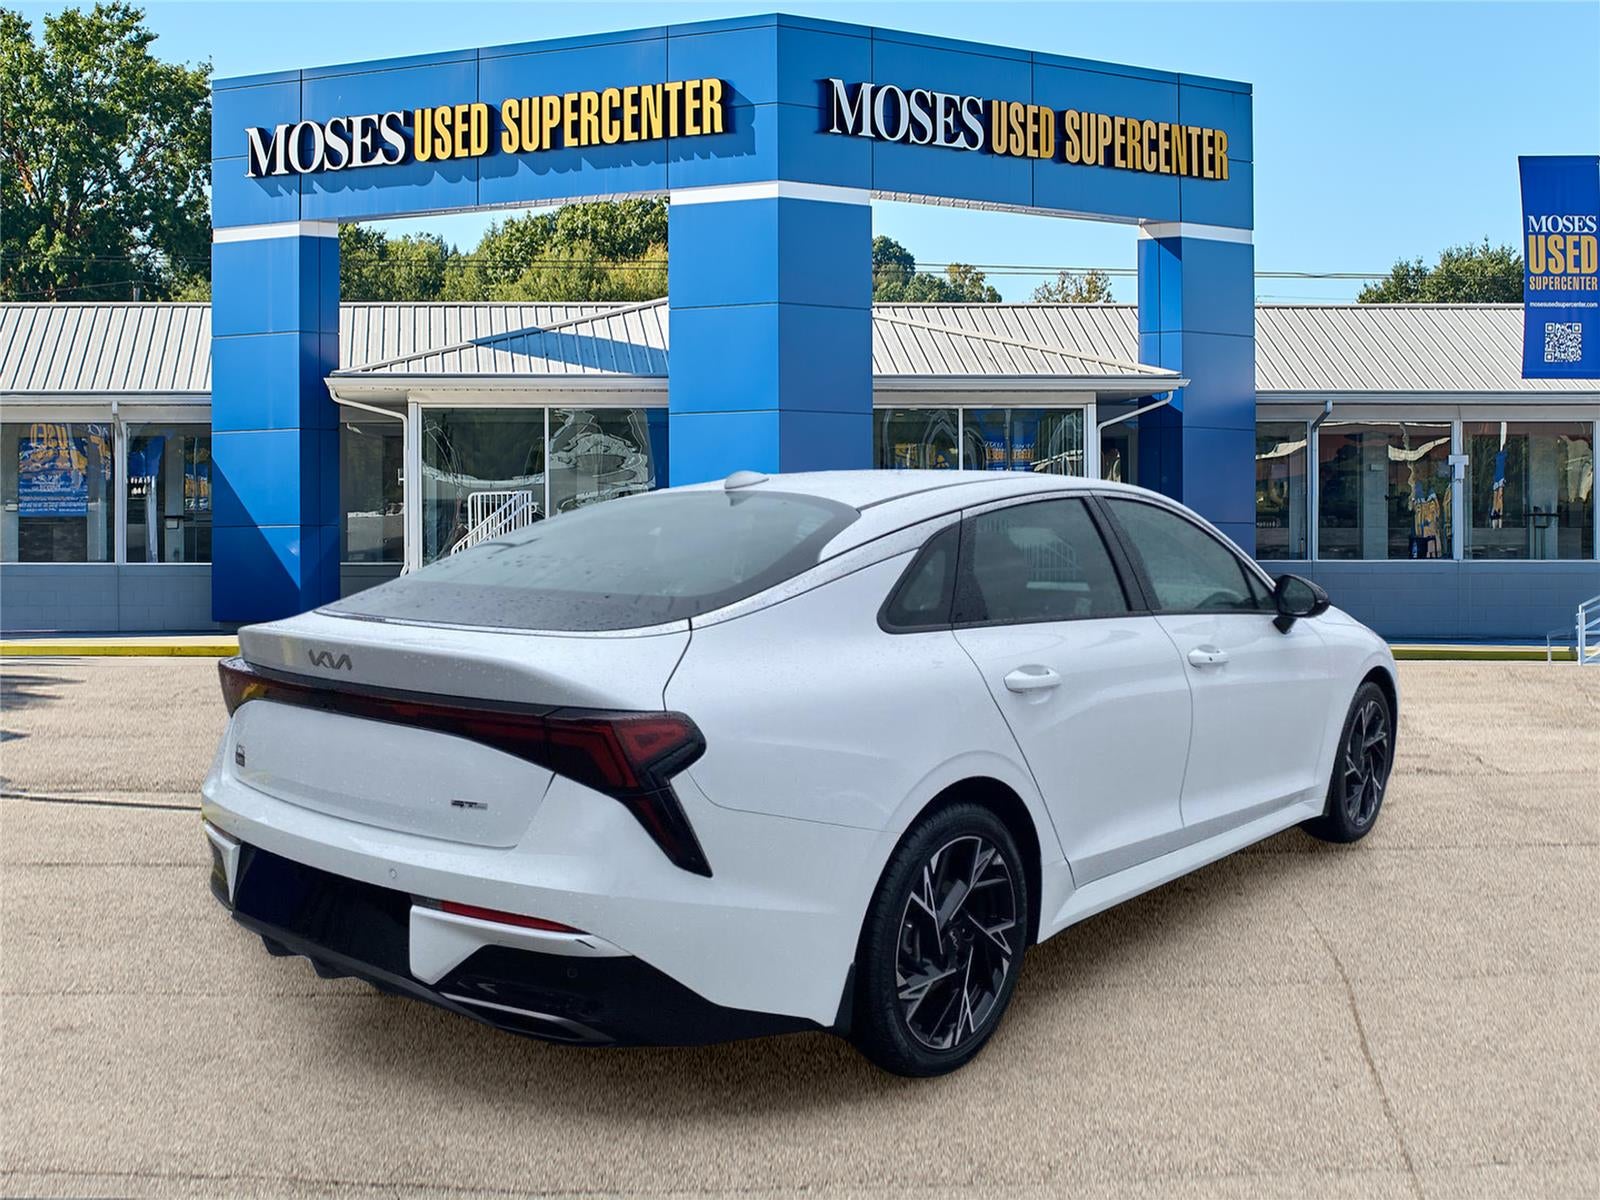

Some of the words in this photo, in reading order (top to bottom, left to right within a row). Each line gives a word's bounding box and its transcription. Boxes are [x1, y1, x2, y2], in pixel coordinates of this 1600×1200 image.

[244, 110, 406, 178] MOSES
[413, 102, 489, 162] USED
[501, 78, 724, 154] SUPERCENTER
[828, 78, 985, 151] MOSES
[991, 99, 1055, 159] USED
[1065, 109, 1230, 181] SUPERCENTER
[1528, 215, 1597, 233] MOSES
[1528, 234, 1598, 274] USED
[1529, 276, 1598, 291] SUPERCENTER
